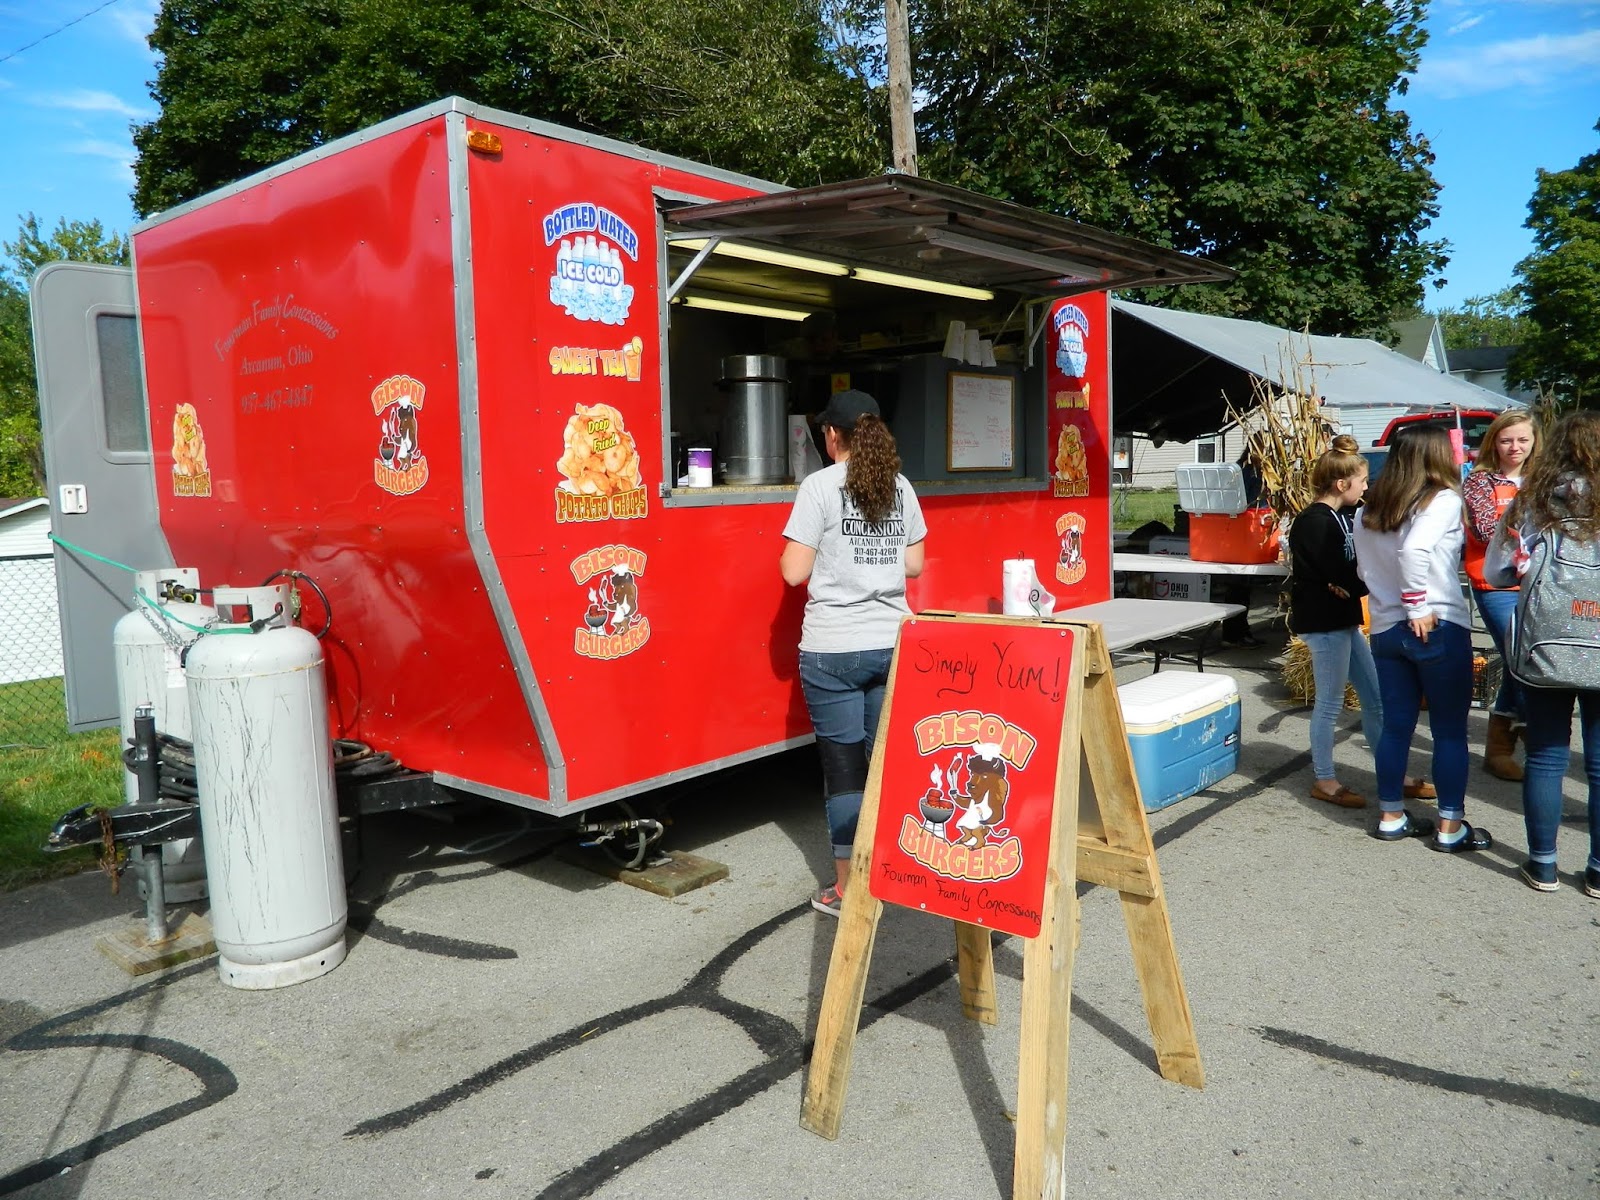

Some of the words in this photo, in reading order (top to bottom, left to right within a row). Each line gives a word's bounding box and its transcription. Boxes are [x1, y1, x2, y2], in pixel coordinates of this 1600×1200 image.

[545, 205, 596, 243] BOTTLED
[599, 209, 638, 258] WATER
[561, 259, 585, 281] ICE
[586, 264, 621, 286] COLD
[252, 295, 283, 327] Family
[283, 293, 339, 339] Concessions
[288, 345, 313, 366] Ohio
[549, 346, 598, 376] SWEET
[599, 349, 627, 377] TEA
[372, 375, 425, 415] BISON
[587, 418, 610, 435] Deep
[593, 432, 616, 452] Fried
[375, 457, 428, 495] BURGERS
[556, 490, 610, 522] POTATO
[612, 487, 647, 519] CHIPS
[843, 519, 905, 536] CONCESSIONS
[885, 538, 903, 547] OHIO
[571, 546, 647, 584] BISON
[1170, 582, 1189, 592] OHIO
[575, 618, 650, 659] BURGERS
[914, 639, 978, 698] Simply
[916, 712, 1035, 769] BISON
[900, 816, 1021, 880] BURGERS
[881, 863, 927, 888] Fourman
[935, 879, 971, 912] Family
[977, 888, 1042, 926] Concessions
